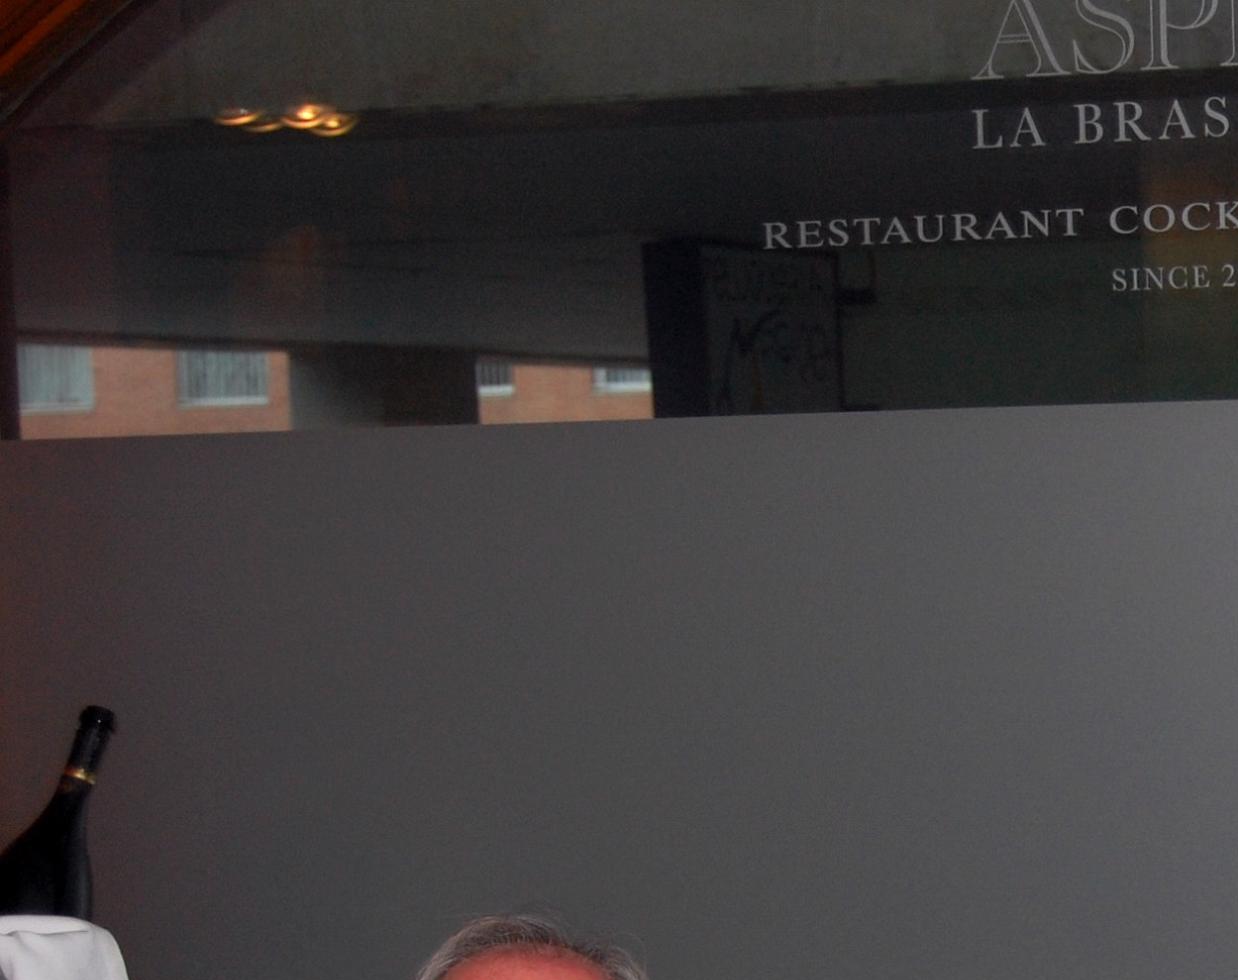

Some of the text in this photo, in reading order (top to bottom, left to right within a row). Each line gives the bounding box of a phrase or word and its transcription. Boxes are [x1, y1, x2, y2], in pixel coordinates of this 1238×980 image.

[972, 107, 1046, 149] LA
[762, 208, 1085, 250] RESTAURANT
[1112, 265, 1210, 292] SINCE
